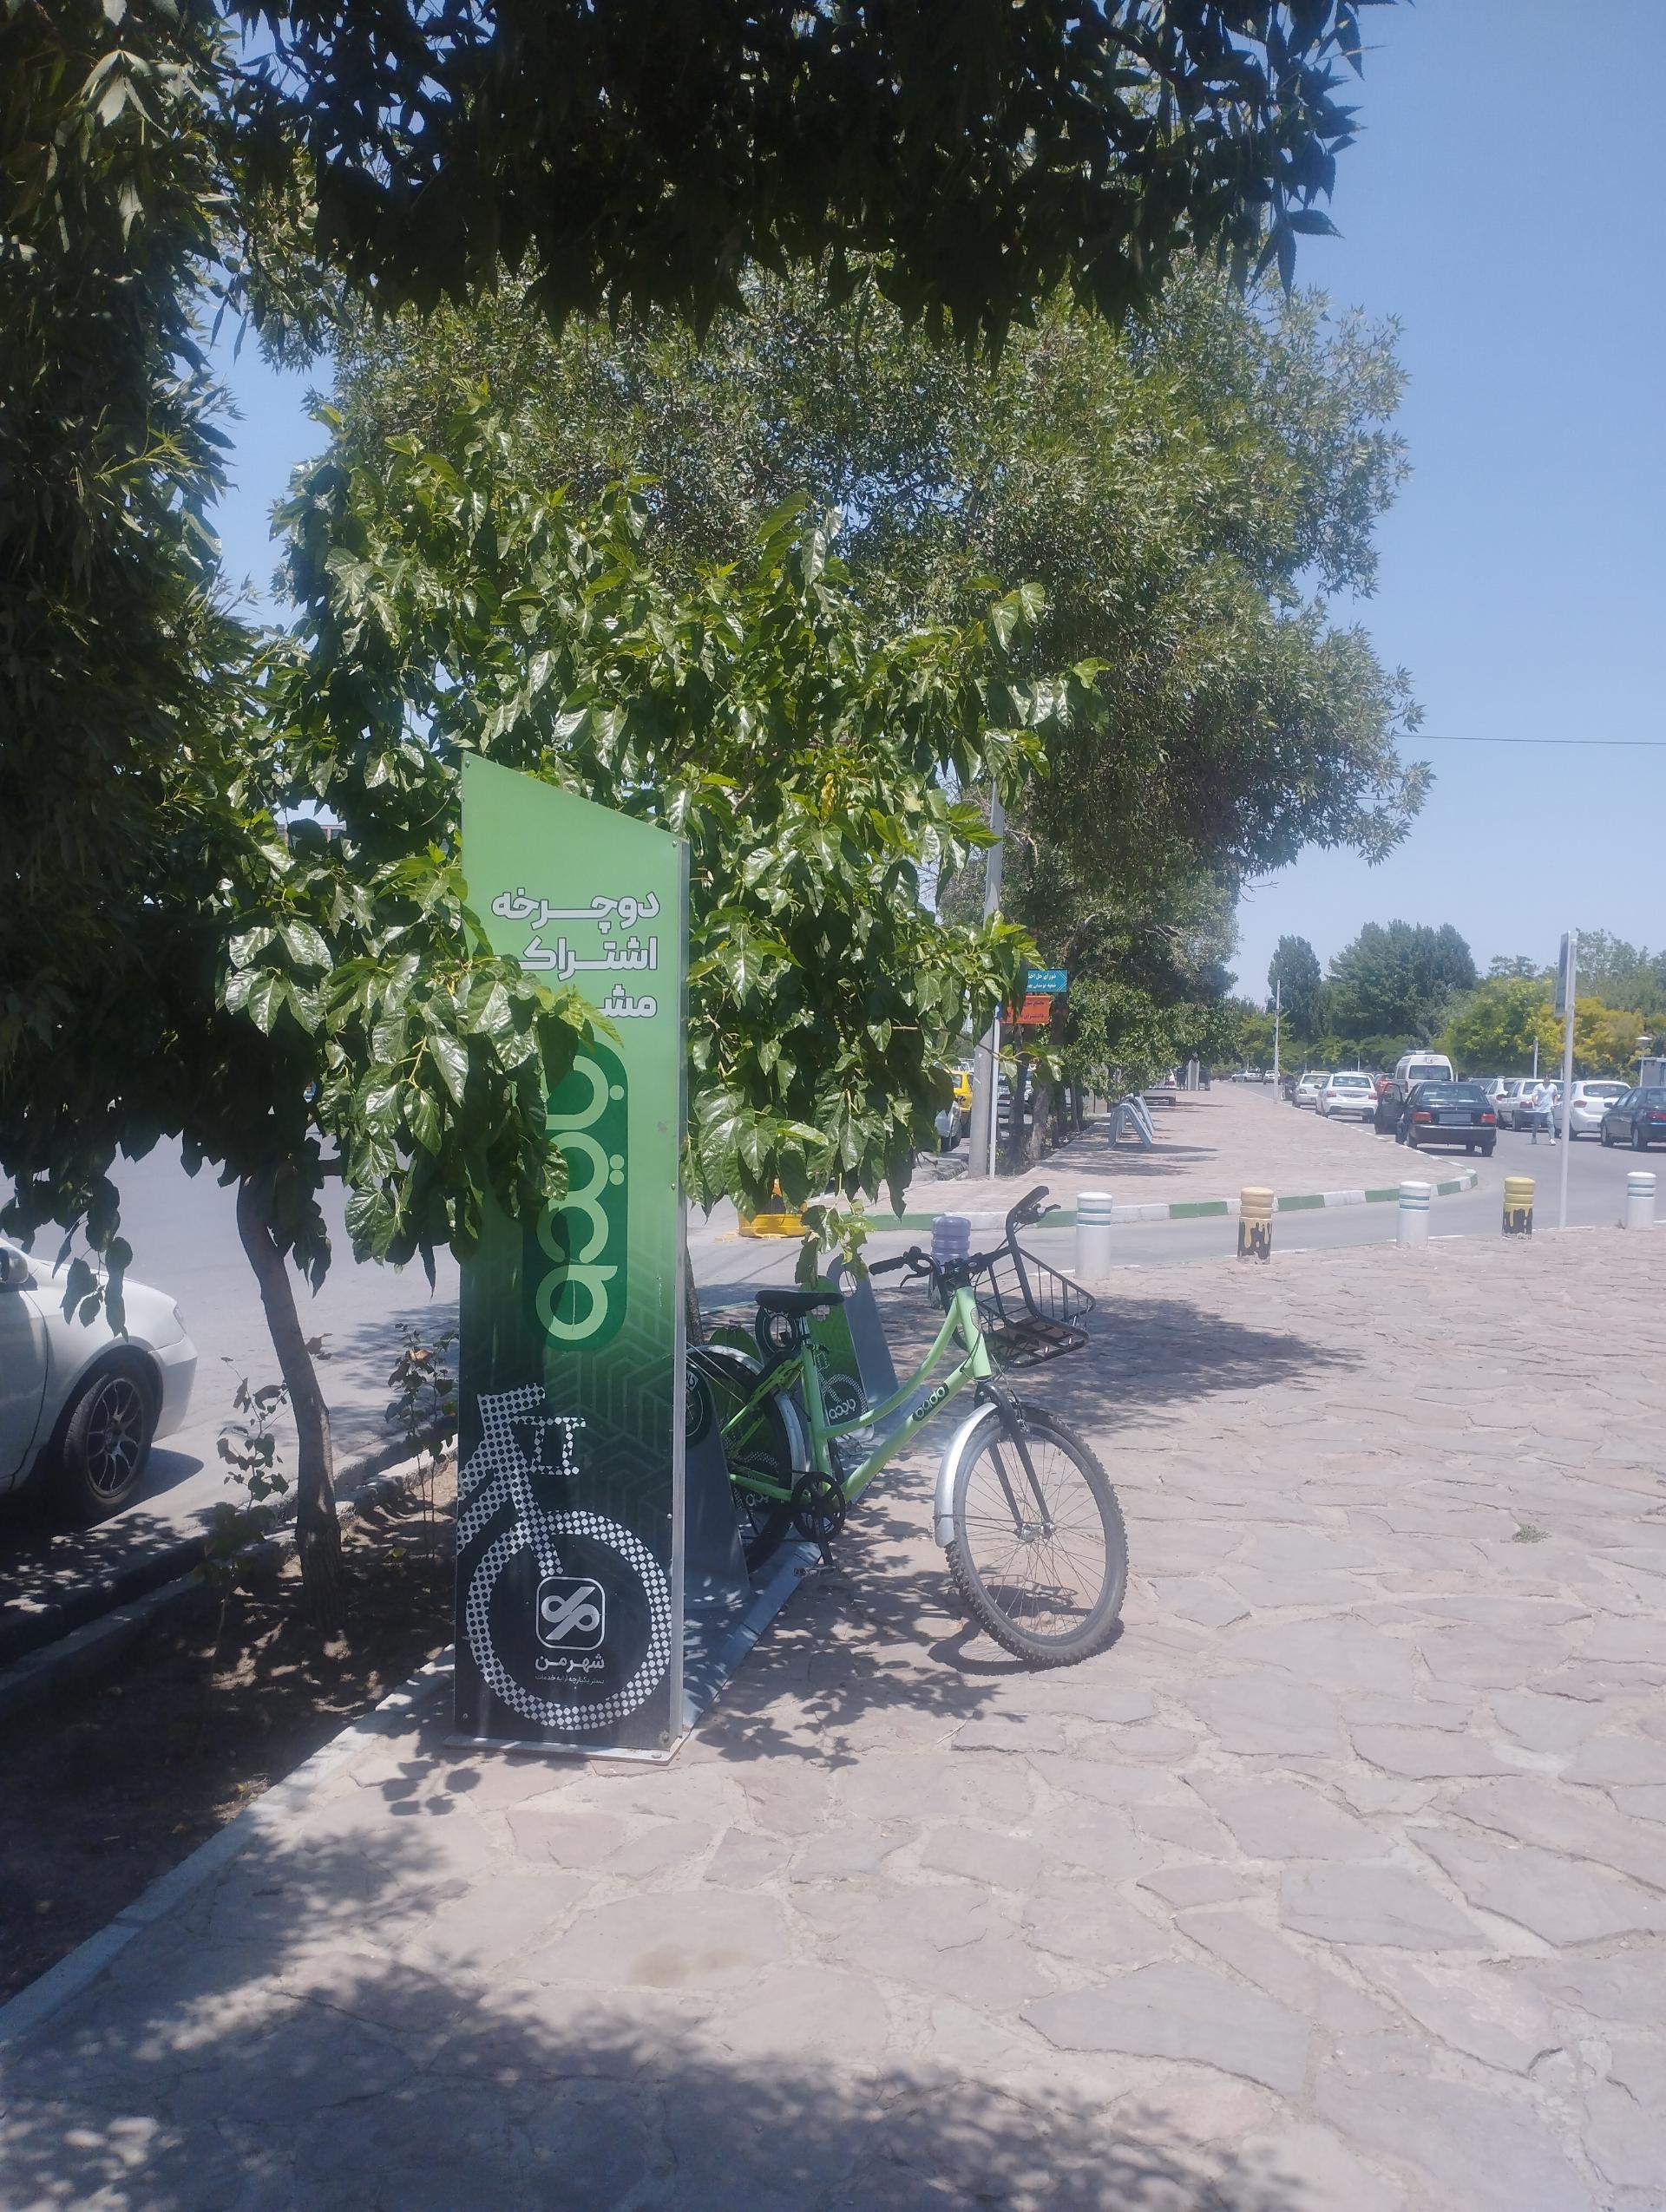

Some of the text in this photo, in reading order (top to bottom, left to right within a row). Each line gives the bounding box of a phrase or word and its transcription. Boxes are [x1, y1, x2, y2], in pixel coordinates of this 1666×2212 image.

[491, 887, 660, 934] دوچرخه
[494, 935, 658, 981] اشتراک
[596, 984, 658, 1018] مش
[535, 1653, 605, 1673] شهر من
